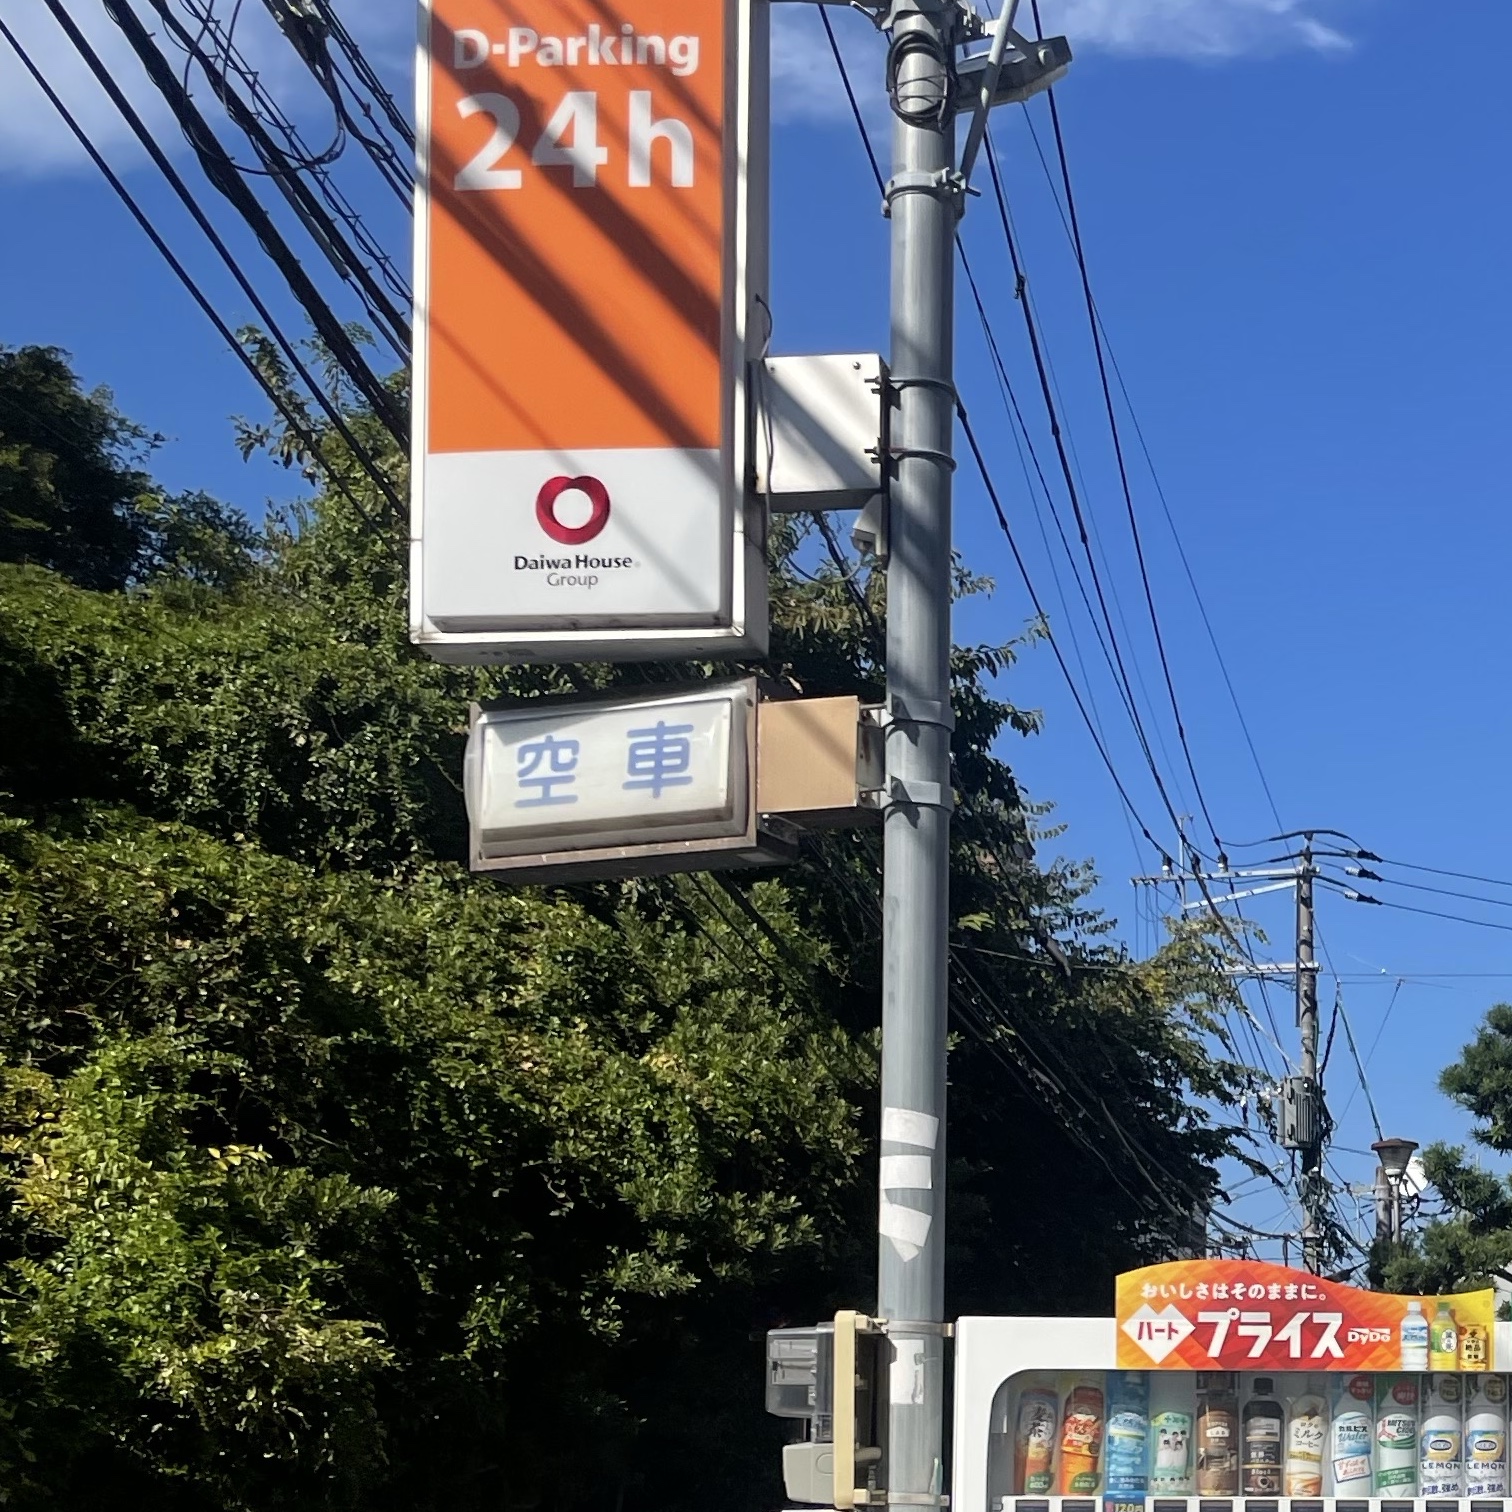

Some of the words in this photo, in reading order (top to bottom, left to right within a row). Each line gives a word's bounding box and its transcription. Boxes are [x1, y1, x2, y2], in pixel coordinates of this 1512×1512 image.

[453, 23, 700, 77] D-Parking
[453, 89, 694, 191] 24h
[514, 555, 573, 571] Daiwa
[575, 555, 633, 570] House
[547, 572, 599, 587] Group
[514, 720, 694, 810] 空車
[1140, 1283, 1327, 1301] おいしさはそのままに。
[1138, 1321, 1179, 1340] ハート
[1198, 1307, 1345, 1358] プライス
[1347, 1328, 1391, 1345] DyDo
[1421, 1462, 1461, 1470] LEMON
[1466, 1462, 1506, 1470] LEMON
